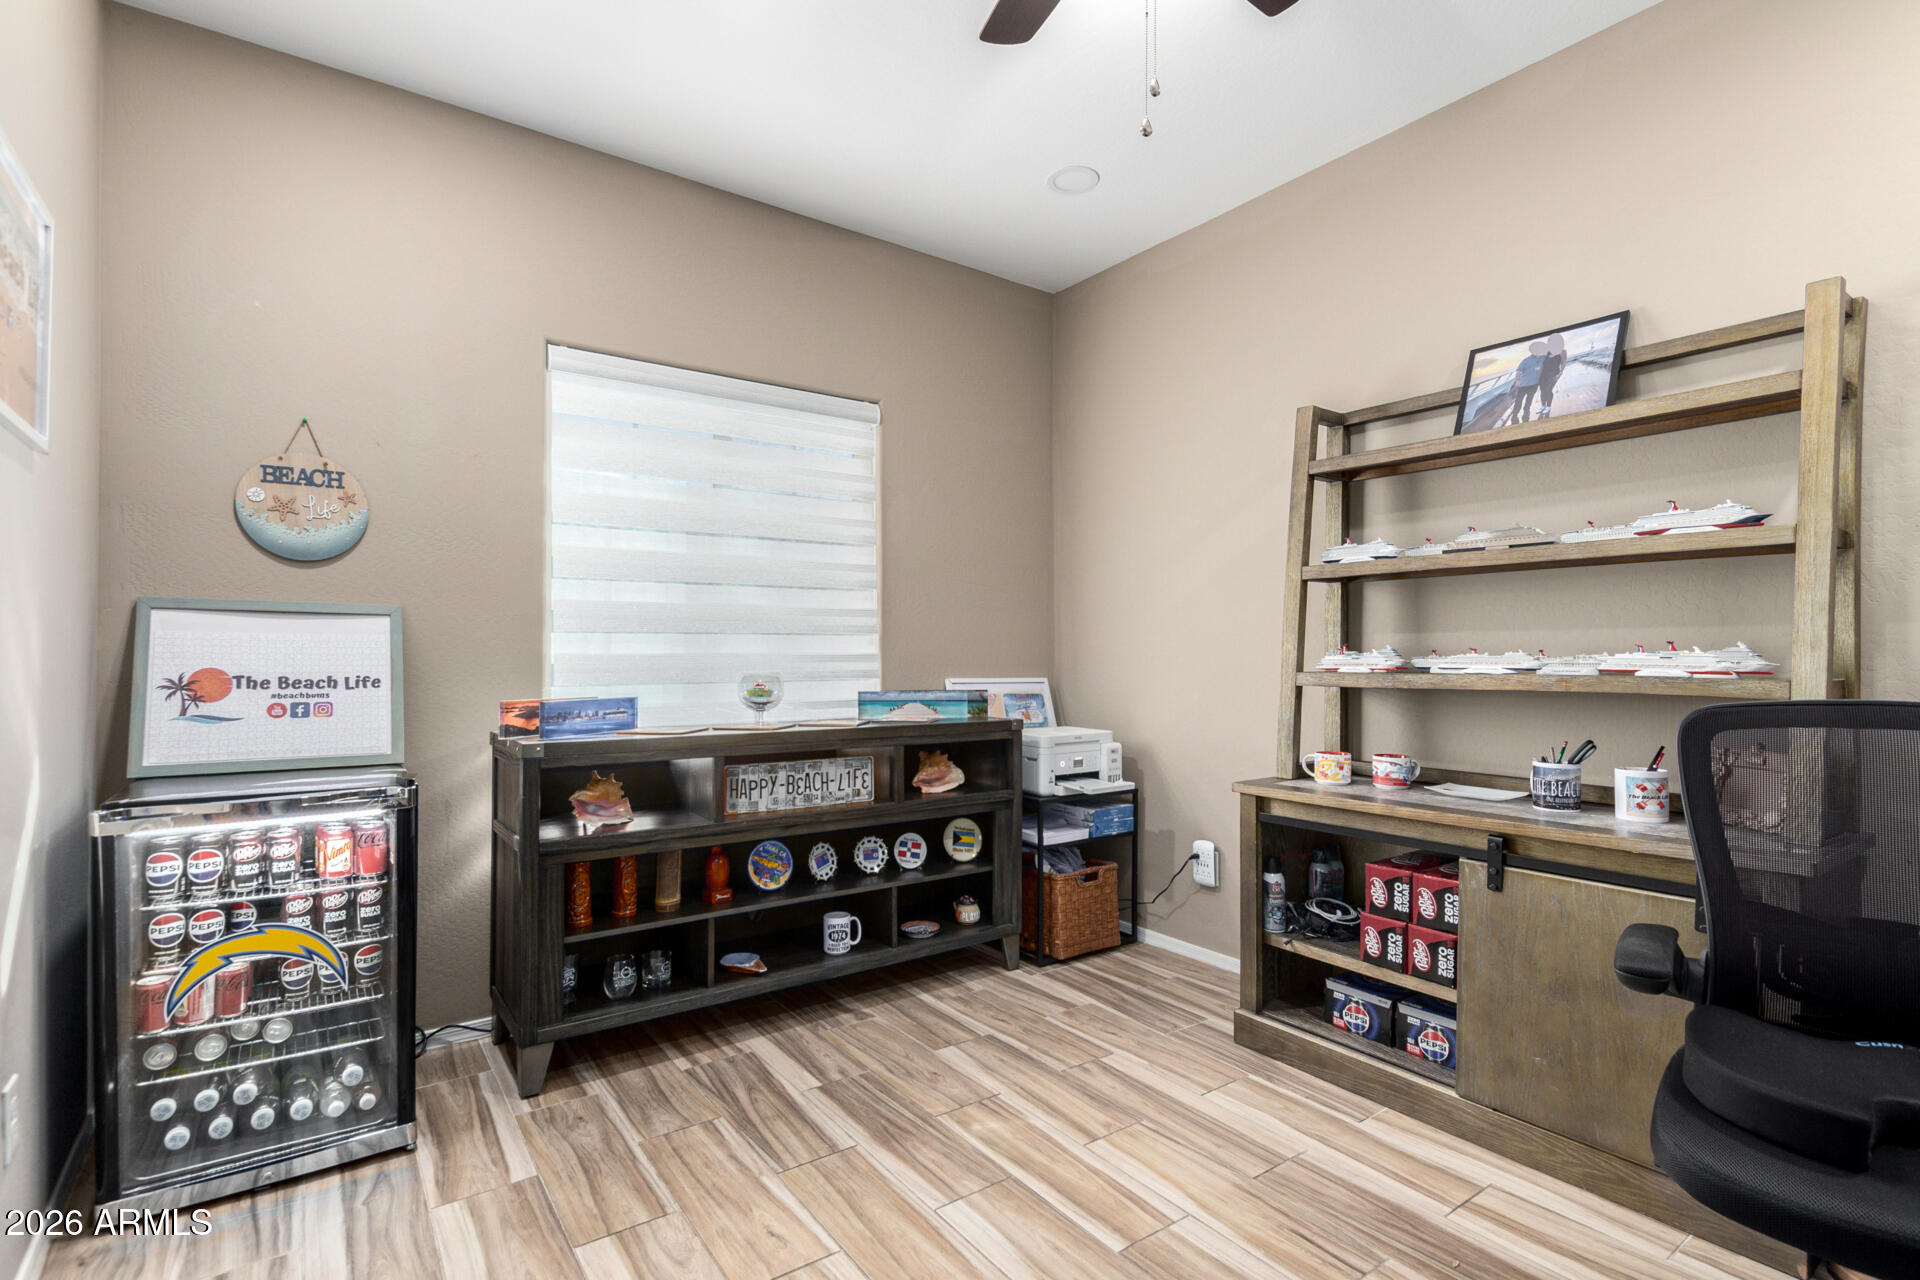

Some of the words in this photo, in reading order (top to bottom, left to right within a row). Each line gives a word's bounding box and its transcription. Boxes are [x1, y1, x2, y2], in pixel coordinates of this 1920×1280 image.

[259, 464, 345, 489] BEACH
[302, 495, 341, 521] Life
[232, 675, 271, 690] The
[278, 675, 338, 690] Beach
[344, 675, 382, 690] Life
[270, 691, 331, 700] #beachbums
[146, 864, 180, 873] PEPSI
[188, 861, 223, 870] PEPSI
[1393, 882, 1402, 911] zero
[1402, 884, 1410, 912] SUGAR
[1444, 893, 1453, 923] zero
[1387, 933, 1395, 961] zero
[1395, 934, 1403, 964] SUGAR
[1437, 946, 1447, 977] zero
[1344, 1011, 1368, 1025] PEPSI
[1420, 1038, 1447, 1052] PEPSI
